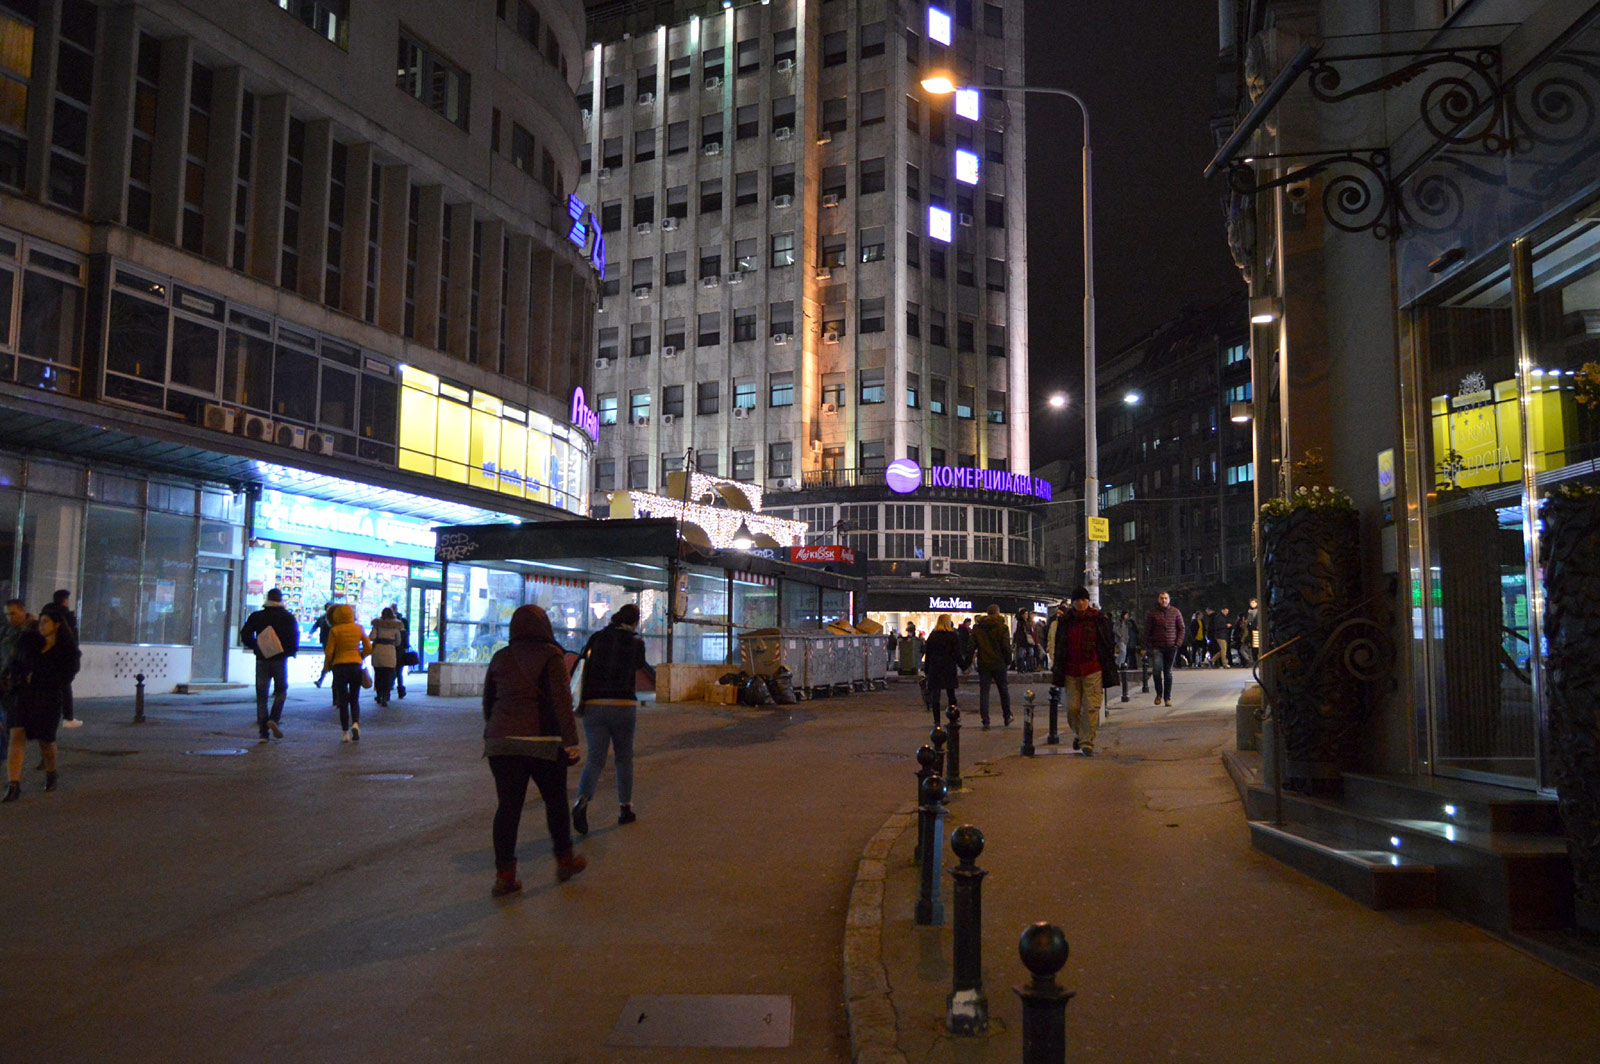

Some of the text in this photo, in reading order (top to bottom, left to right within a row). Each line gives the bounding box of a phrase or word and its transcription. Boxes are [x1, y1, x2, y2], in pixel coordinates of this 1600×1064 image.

[1456, 400, 1490, 418] HOTEL
[932, 465, 1033, 496] КОМЕРЦИЈАЛНА
[929, 597, 972, 609] MaxMara
